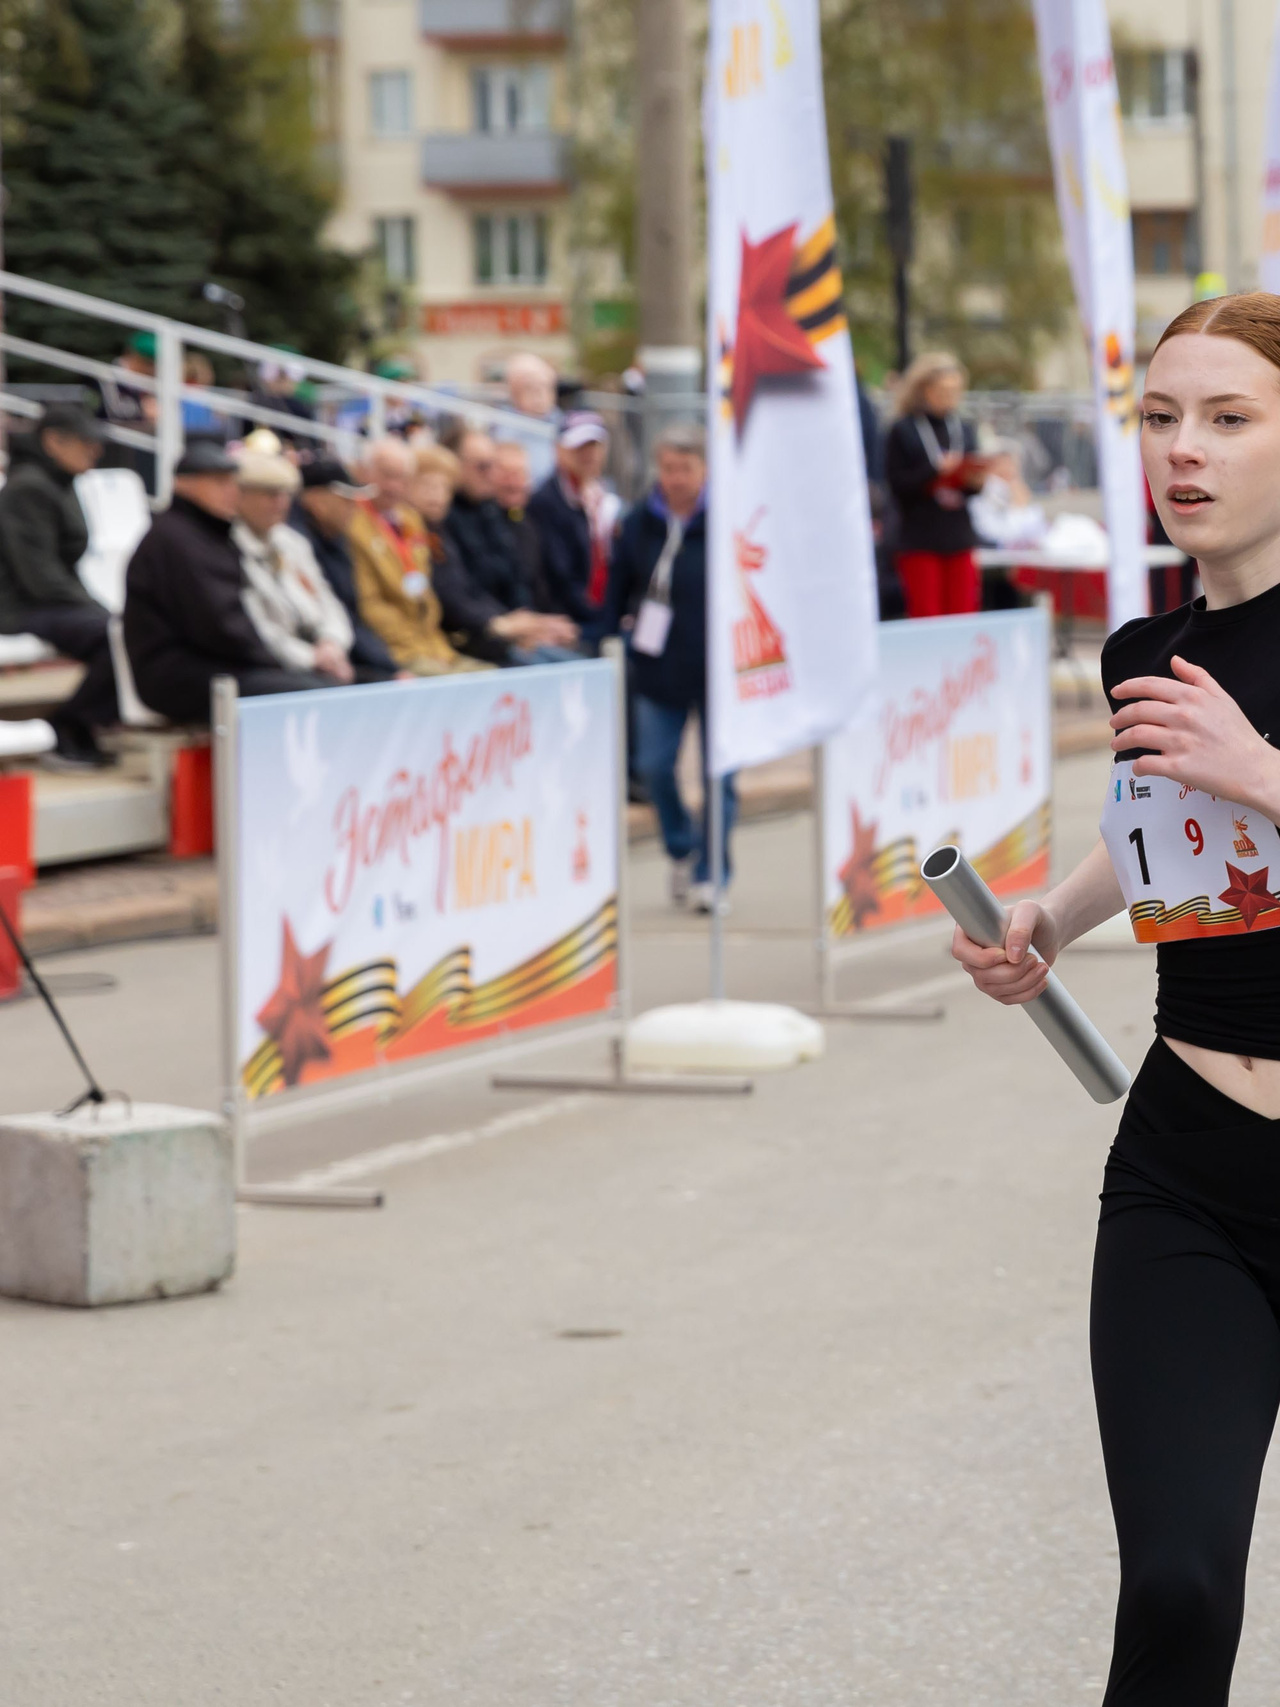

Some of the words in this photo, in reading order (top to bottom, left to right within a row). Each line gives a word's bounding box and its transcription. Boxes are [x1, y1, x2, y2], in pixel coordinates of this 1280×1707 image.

[453, 815, 537, 912] МИРА
[1128, 828, 1151, 885] 1
[1184, 818, 1204, 856] 9
